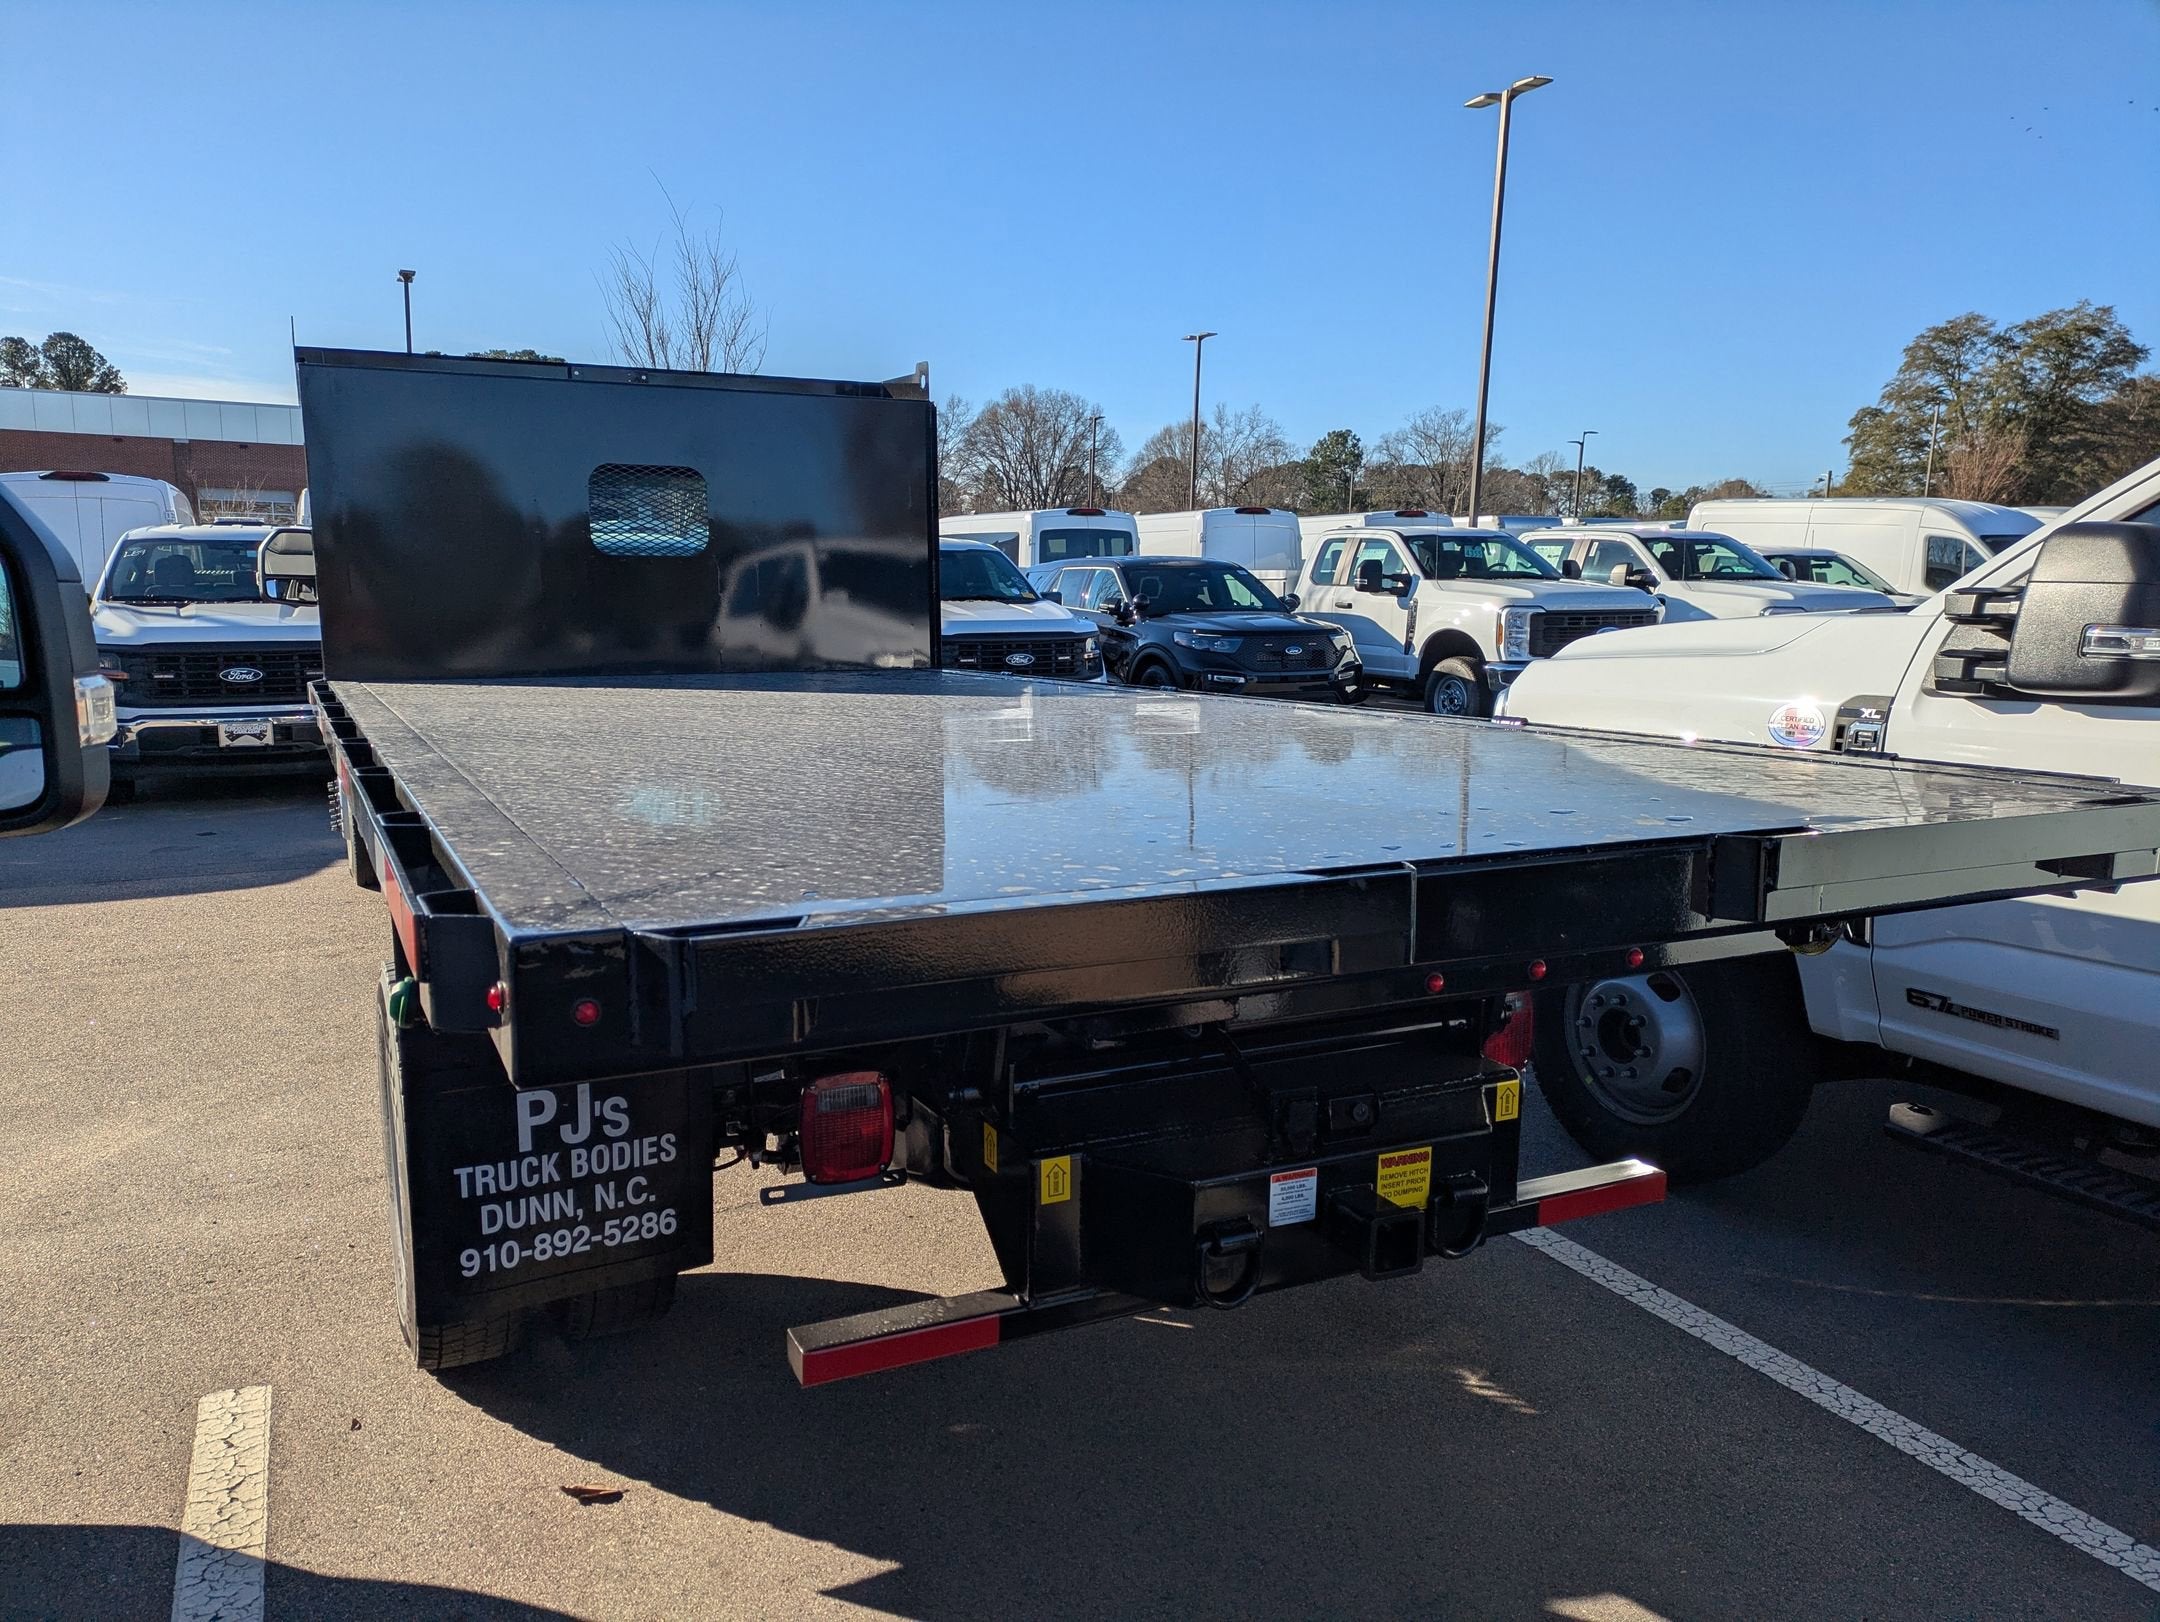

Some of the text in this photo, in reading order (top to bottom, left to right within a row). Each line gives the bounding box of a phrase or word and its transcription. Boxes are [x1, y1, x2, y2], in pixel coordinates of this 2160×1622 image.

[227, 669, 257, 680] Ford
[1860, 708, 1881, 719] XL
[1961, 1007, 2003, 1026] POWER
[2005, 1016, 2056, 1039] STROKE
[453, 1133, 677, 1199] TRUCK BODIES
[1381, 1151, 1430, 1169] WARNING
[1380, 1167, 1429, 1181] REMOVE HITCH
[1380, 1176, 1426, 1190] INSERT PRIOR
[1393, 1186, 1424, 1197] DUMPING
[481, 1175, 656, 1235] DUNN, N.C.
[459, 1208, 677, 1278] 910-892-5286
